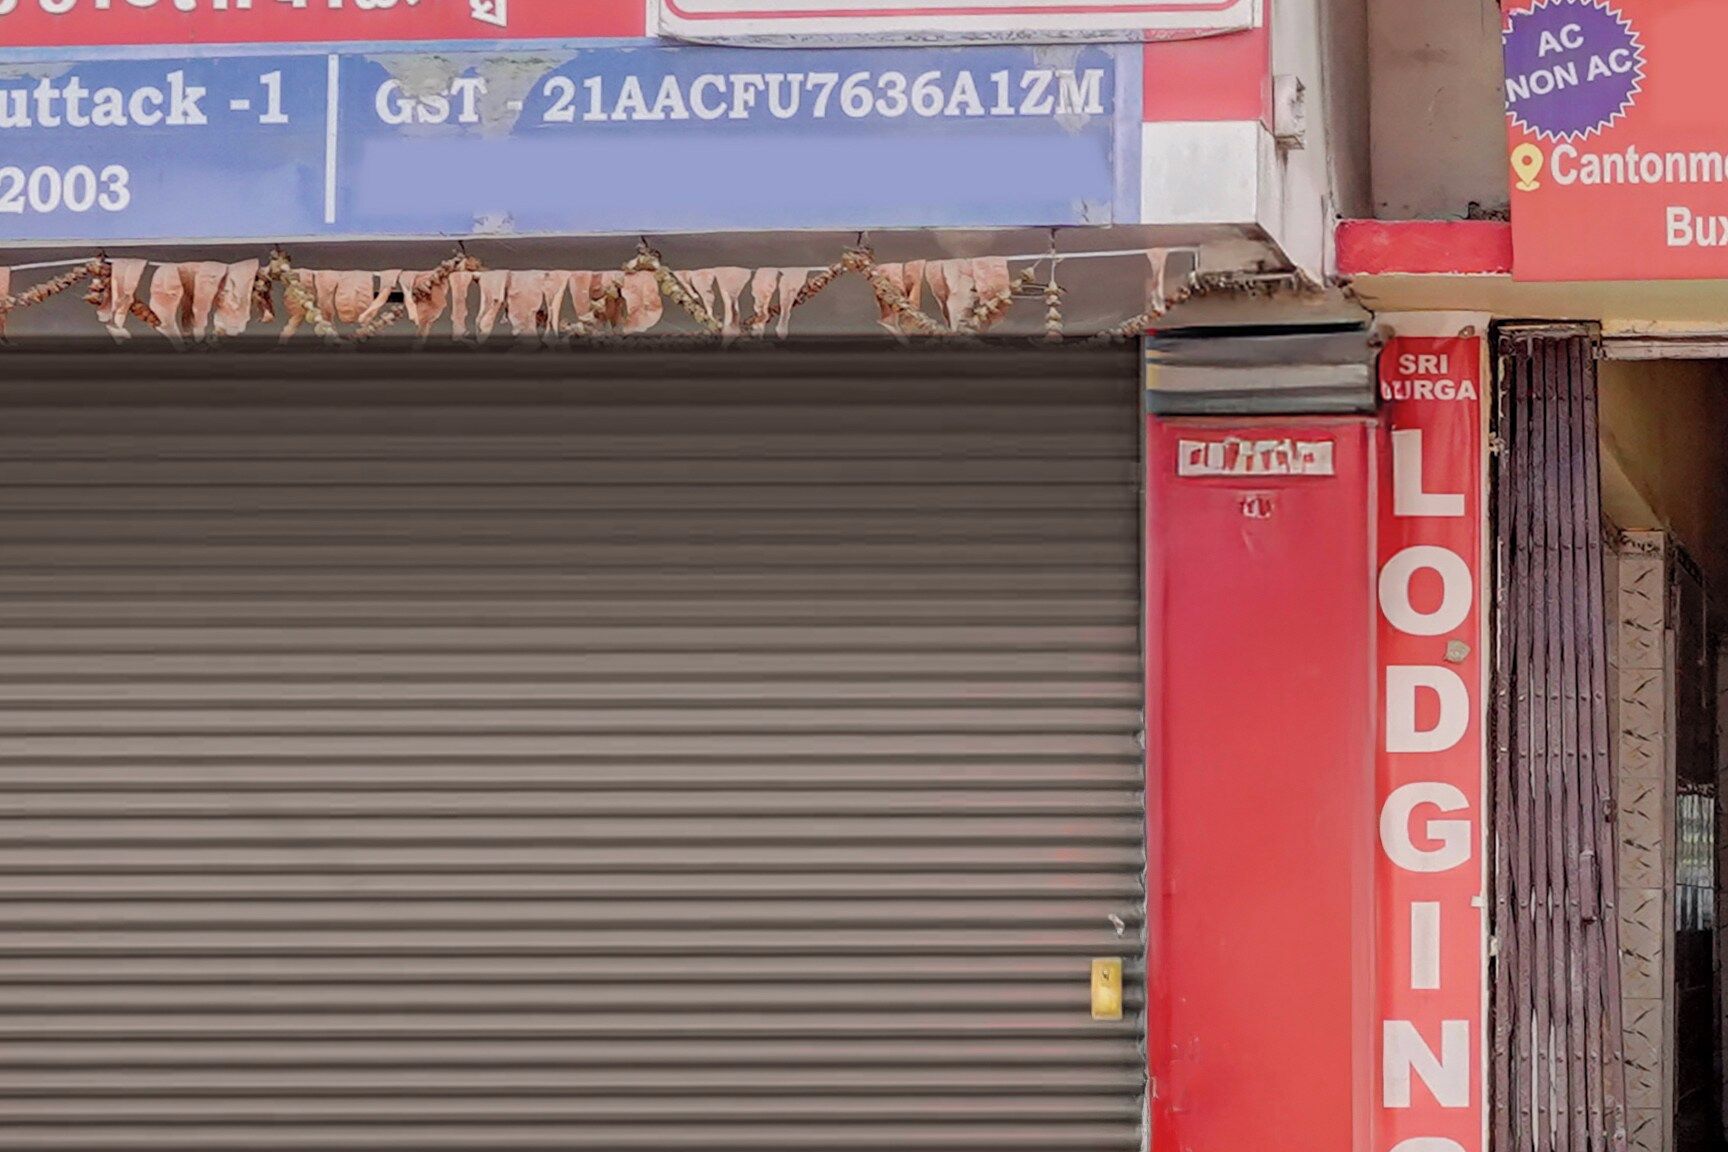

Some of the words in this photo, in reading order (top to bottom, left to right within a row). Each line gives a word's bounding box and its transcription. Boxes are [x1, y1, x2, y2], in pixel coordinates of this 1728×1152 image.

[1538, 23, 1584, 57] AC
[375, 78, 488, 126] GST
[542, 69, 1103, 123] 21AACFU7636A1ZM
[1505, 61, 1578, 102] NON
[1587, 48, 1632, 81] AC
[0, 164, 130, 213] 2003
[1399, 353, 1448, 375] SRI
